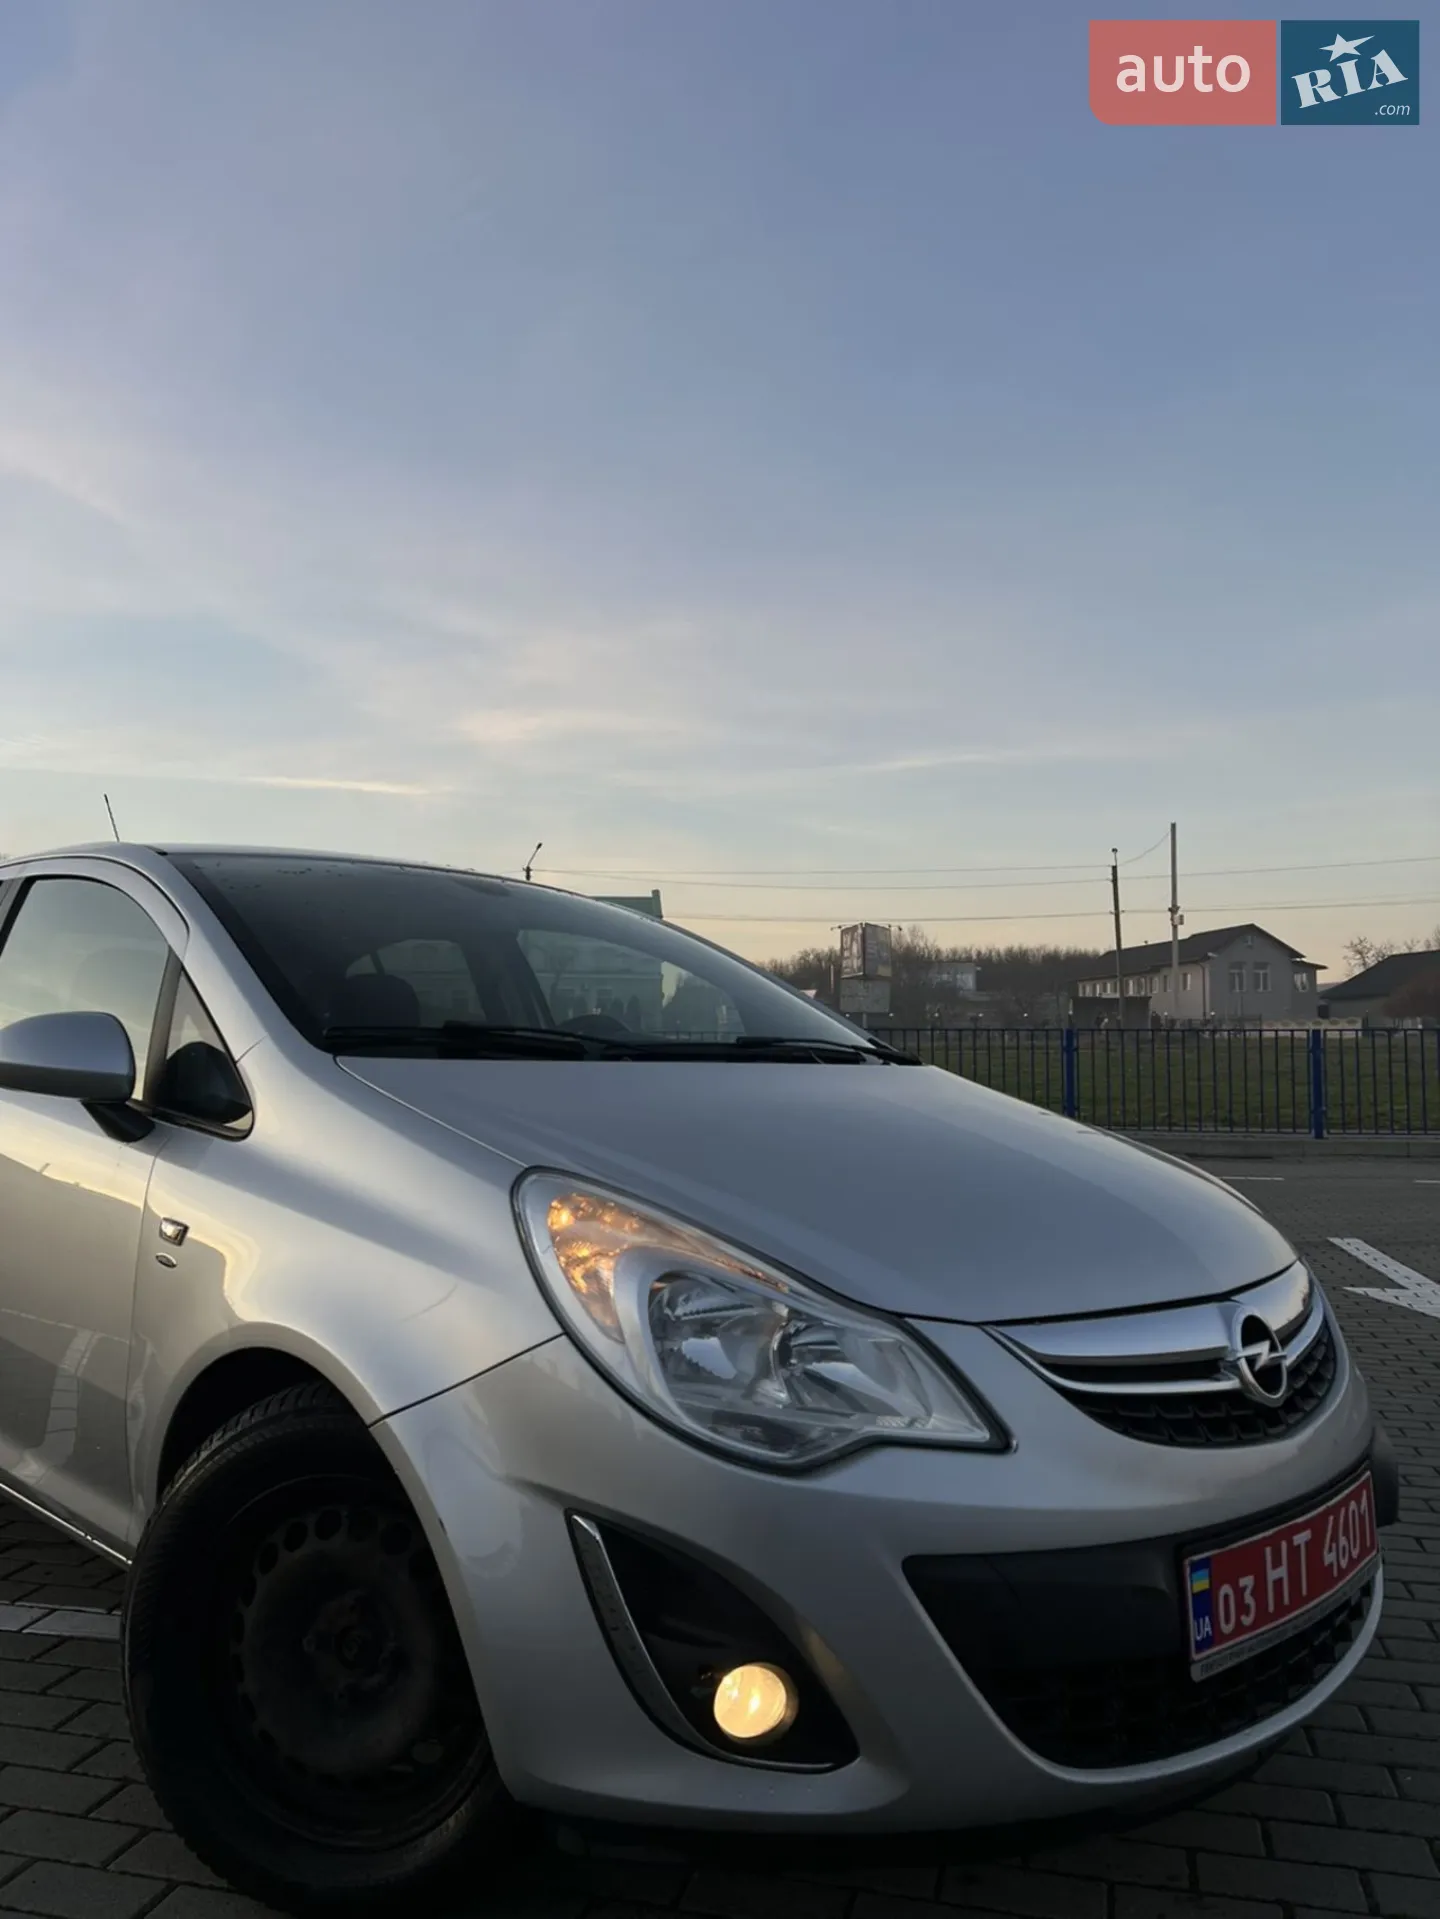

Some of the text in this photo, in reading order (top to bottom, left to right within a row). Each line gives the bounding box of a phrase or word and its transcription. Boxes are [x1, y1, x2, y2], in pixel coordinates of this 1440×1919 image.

[1218, 1575, 1256, 1635] 03
[1265, 1530, 1312, 1614] HT
[1324, 1490, 1371, 1577] 4601
[1194, 1616, 1212, 1641] UA
